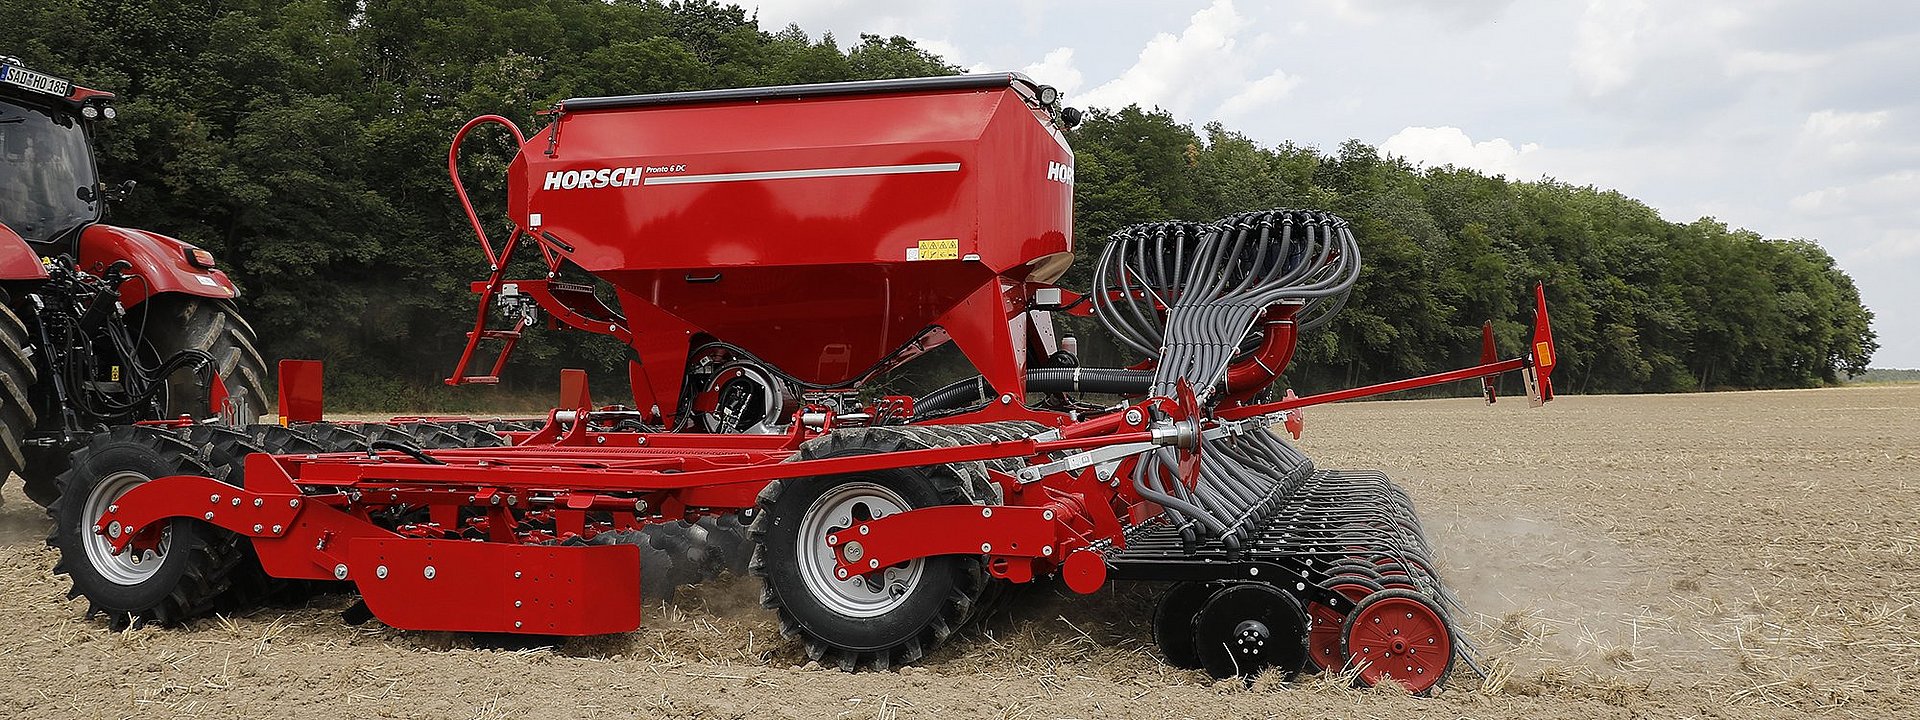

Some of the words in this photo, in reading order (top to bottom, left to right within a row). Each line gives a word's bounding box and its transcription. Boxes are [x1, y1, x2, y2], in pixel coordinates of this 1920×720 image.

[7, 69, 28, 84] SAD
[33, 75, 47, 89] HO
[47, 80, 67, 94] 185
[543, 167, 643, 191] HORSCH
[646, 165, 668, 174] Pronto
